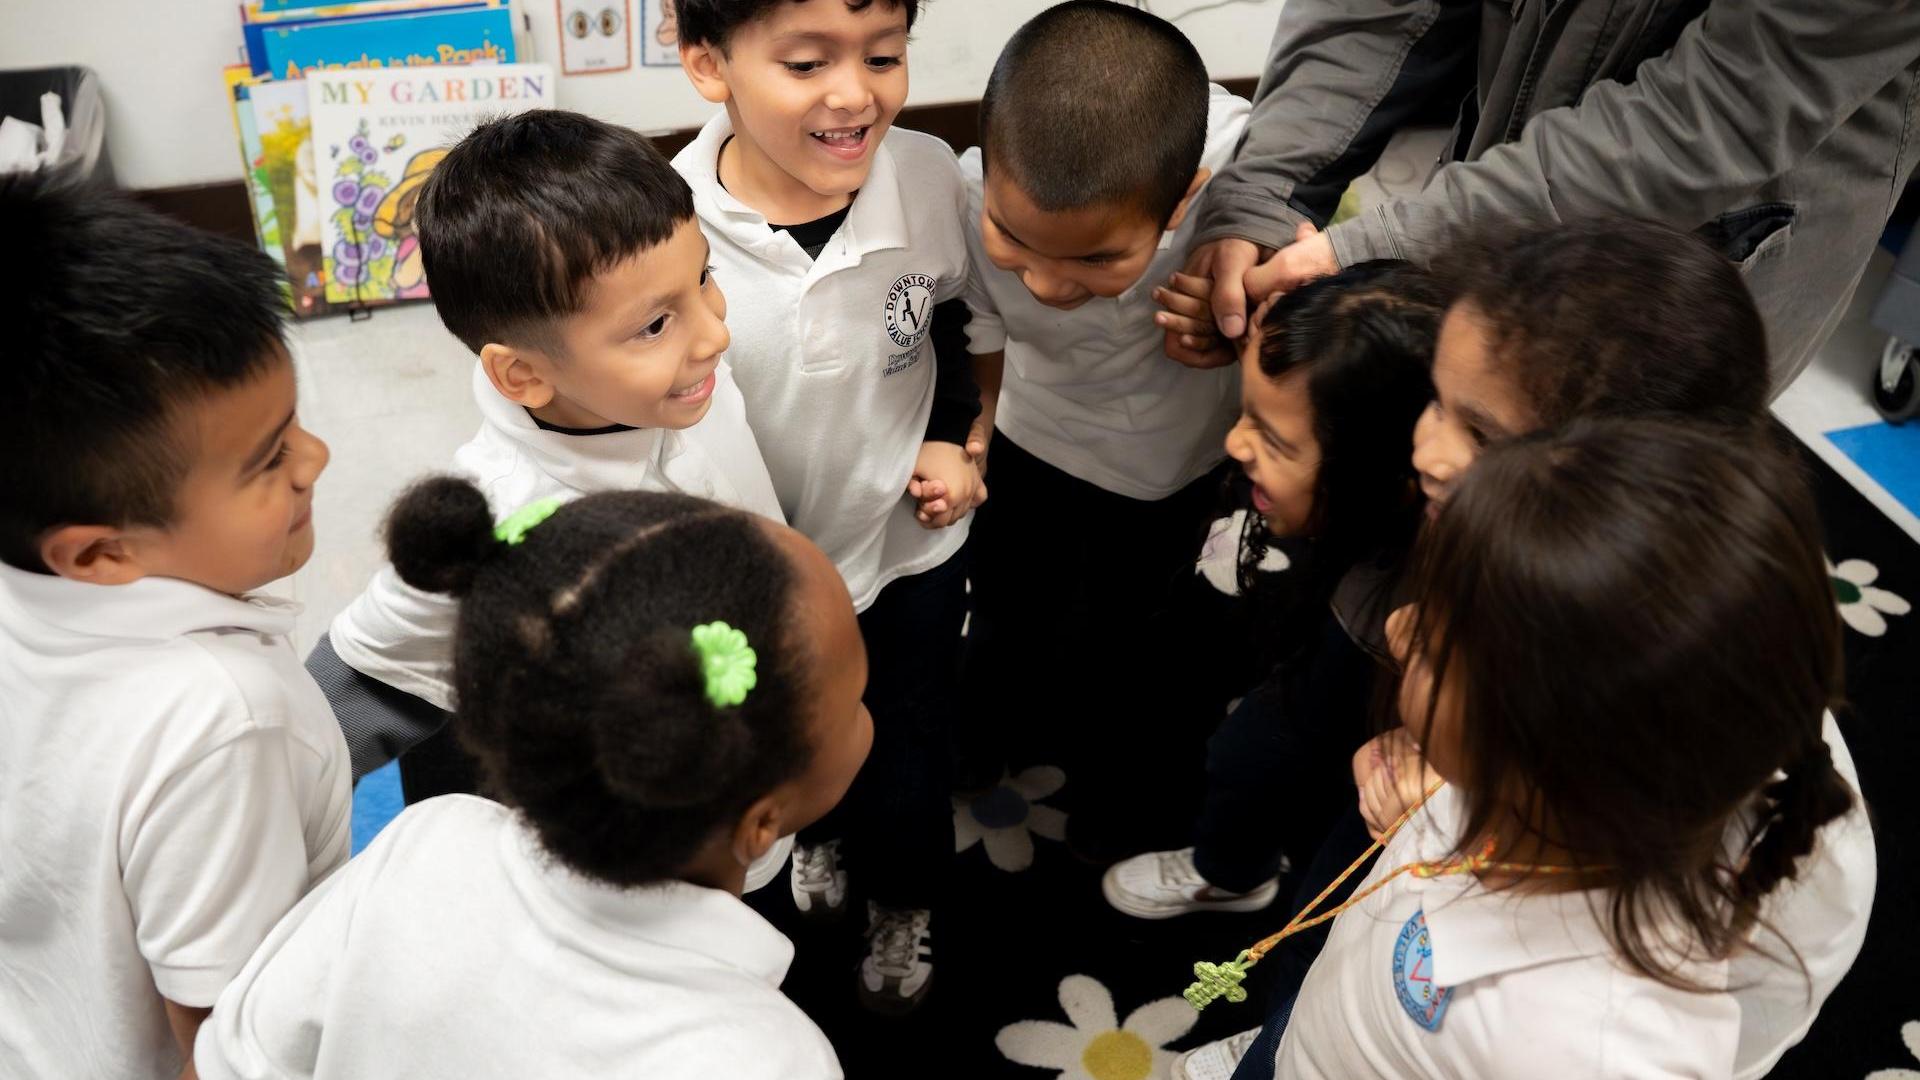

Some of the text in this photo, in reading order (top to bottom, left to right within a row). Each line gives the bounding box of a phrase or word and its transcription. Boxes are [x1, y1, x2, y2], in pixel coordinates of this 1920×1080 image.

[322, 75, 544, 104] MY GARDEN
[378, 115, 425, 127] KEVIN
[888, 323, 911, 345] VALUE
